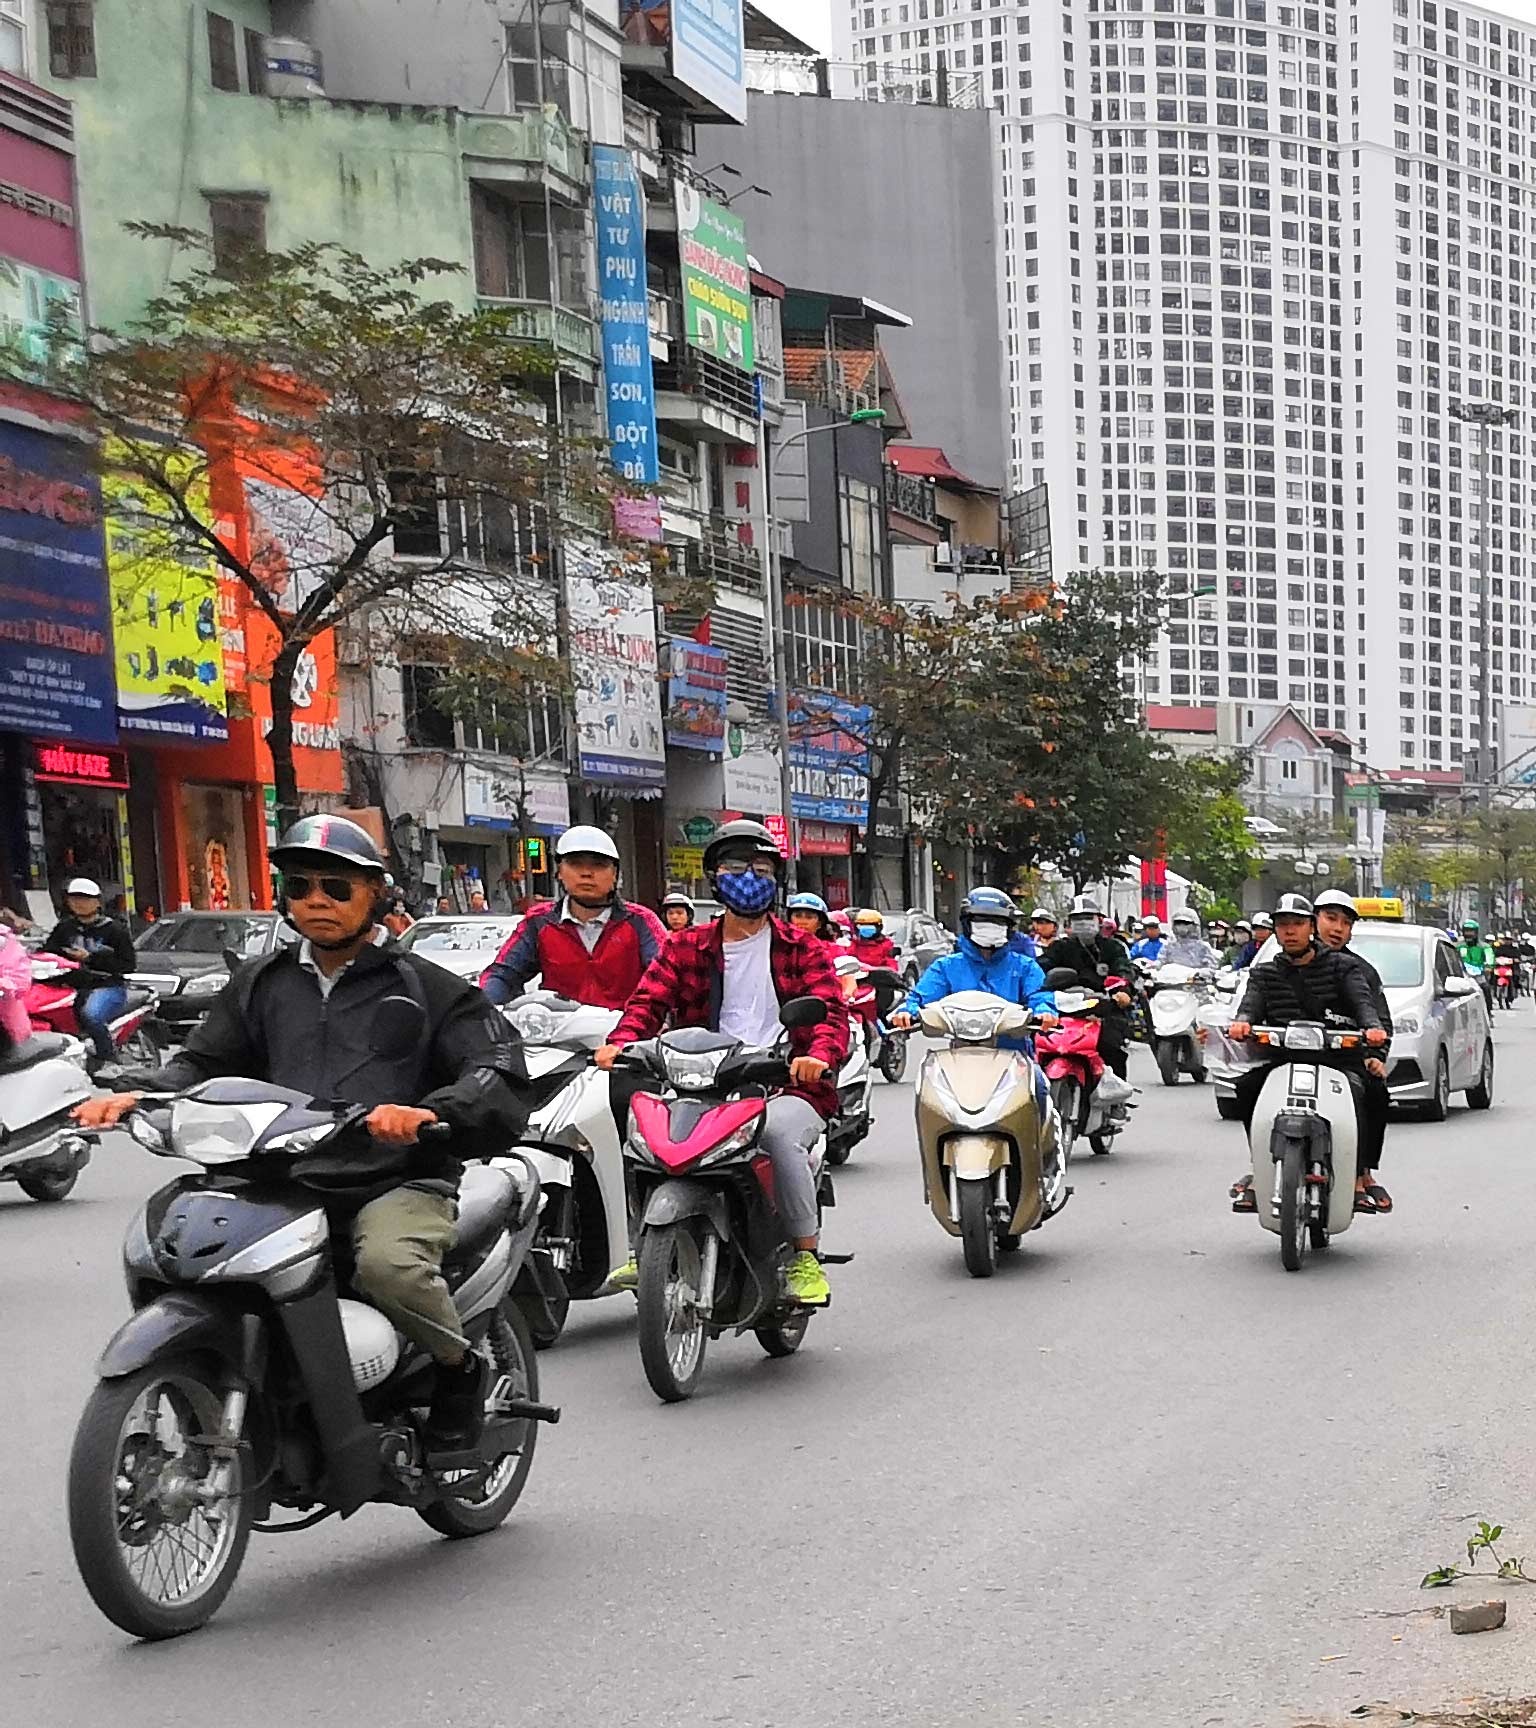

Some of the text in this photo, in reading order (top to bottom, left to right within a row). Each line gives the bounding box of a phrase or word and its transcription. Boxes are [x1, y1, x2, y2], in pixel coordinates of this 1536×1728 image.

[602, 195, 632, 224] VẬT
[607, 226, 630, 246] TƯ
[606, 257, 637, 287] PHỤ
[615, 424, 647, 450] BỘT
